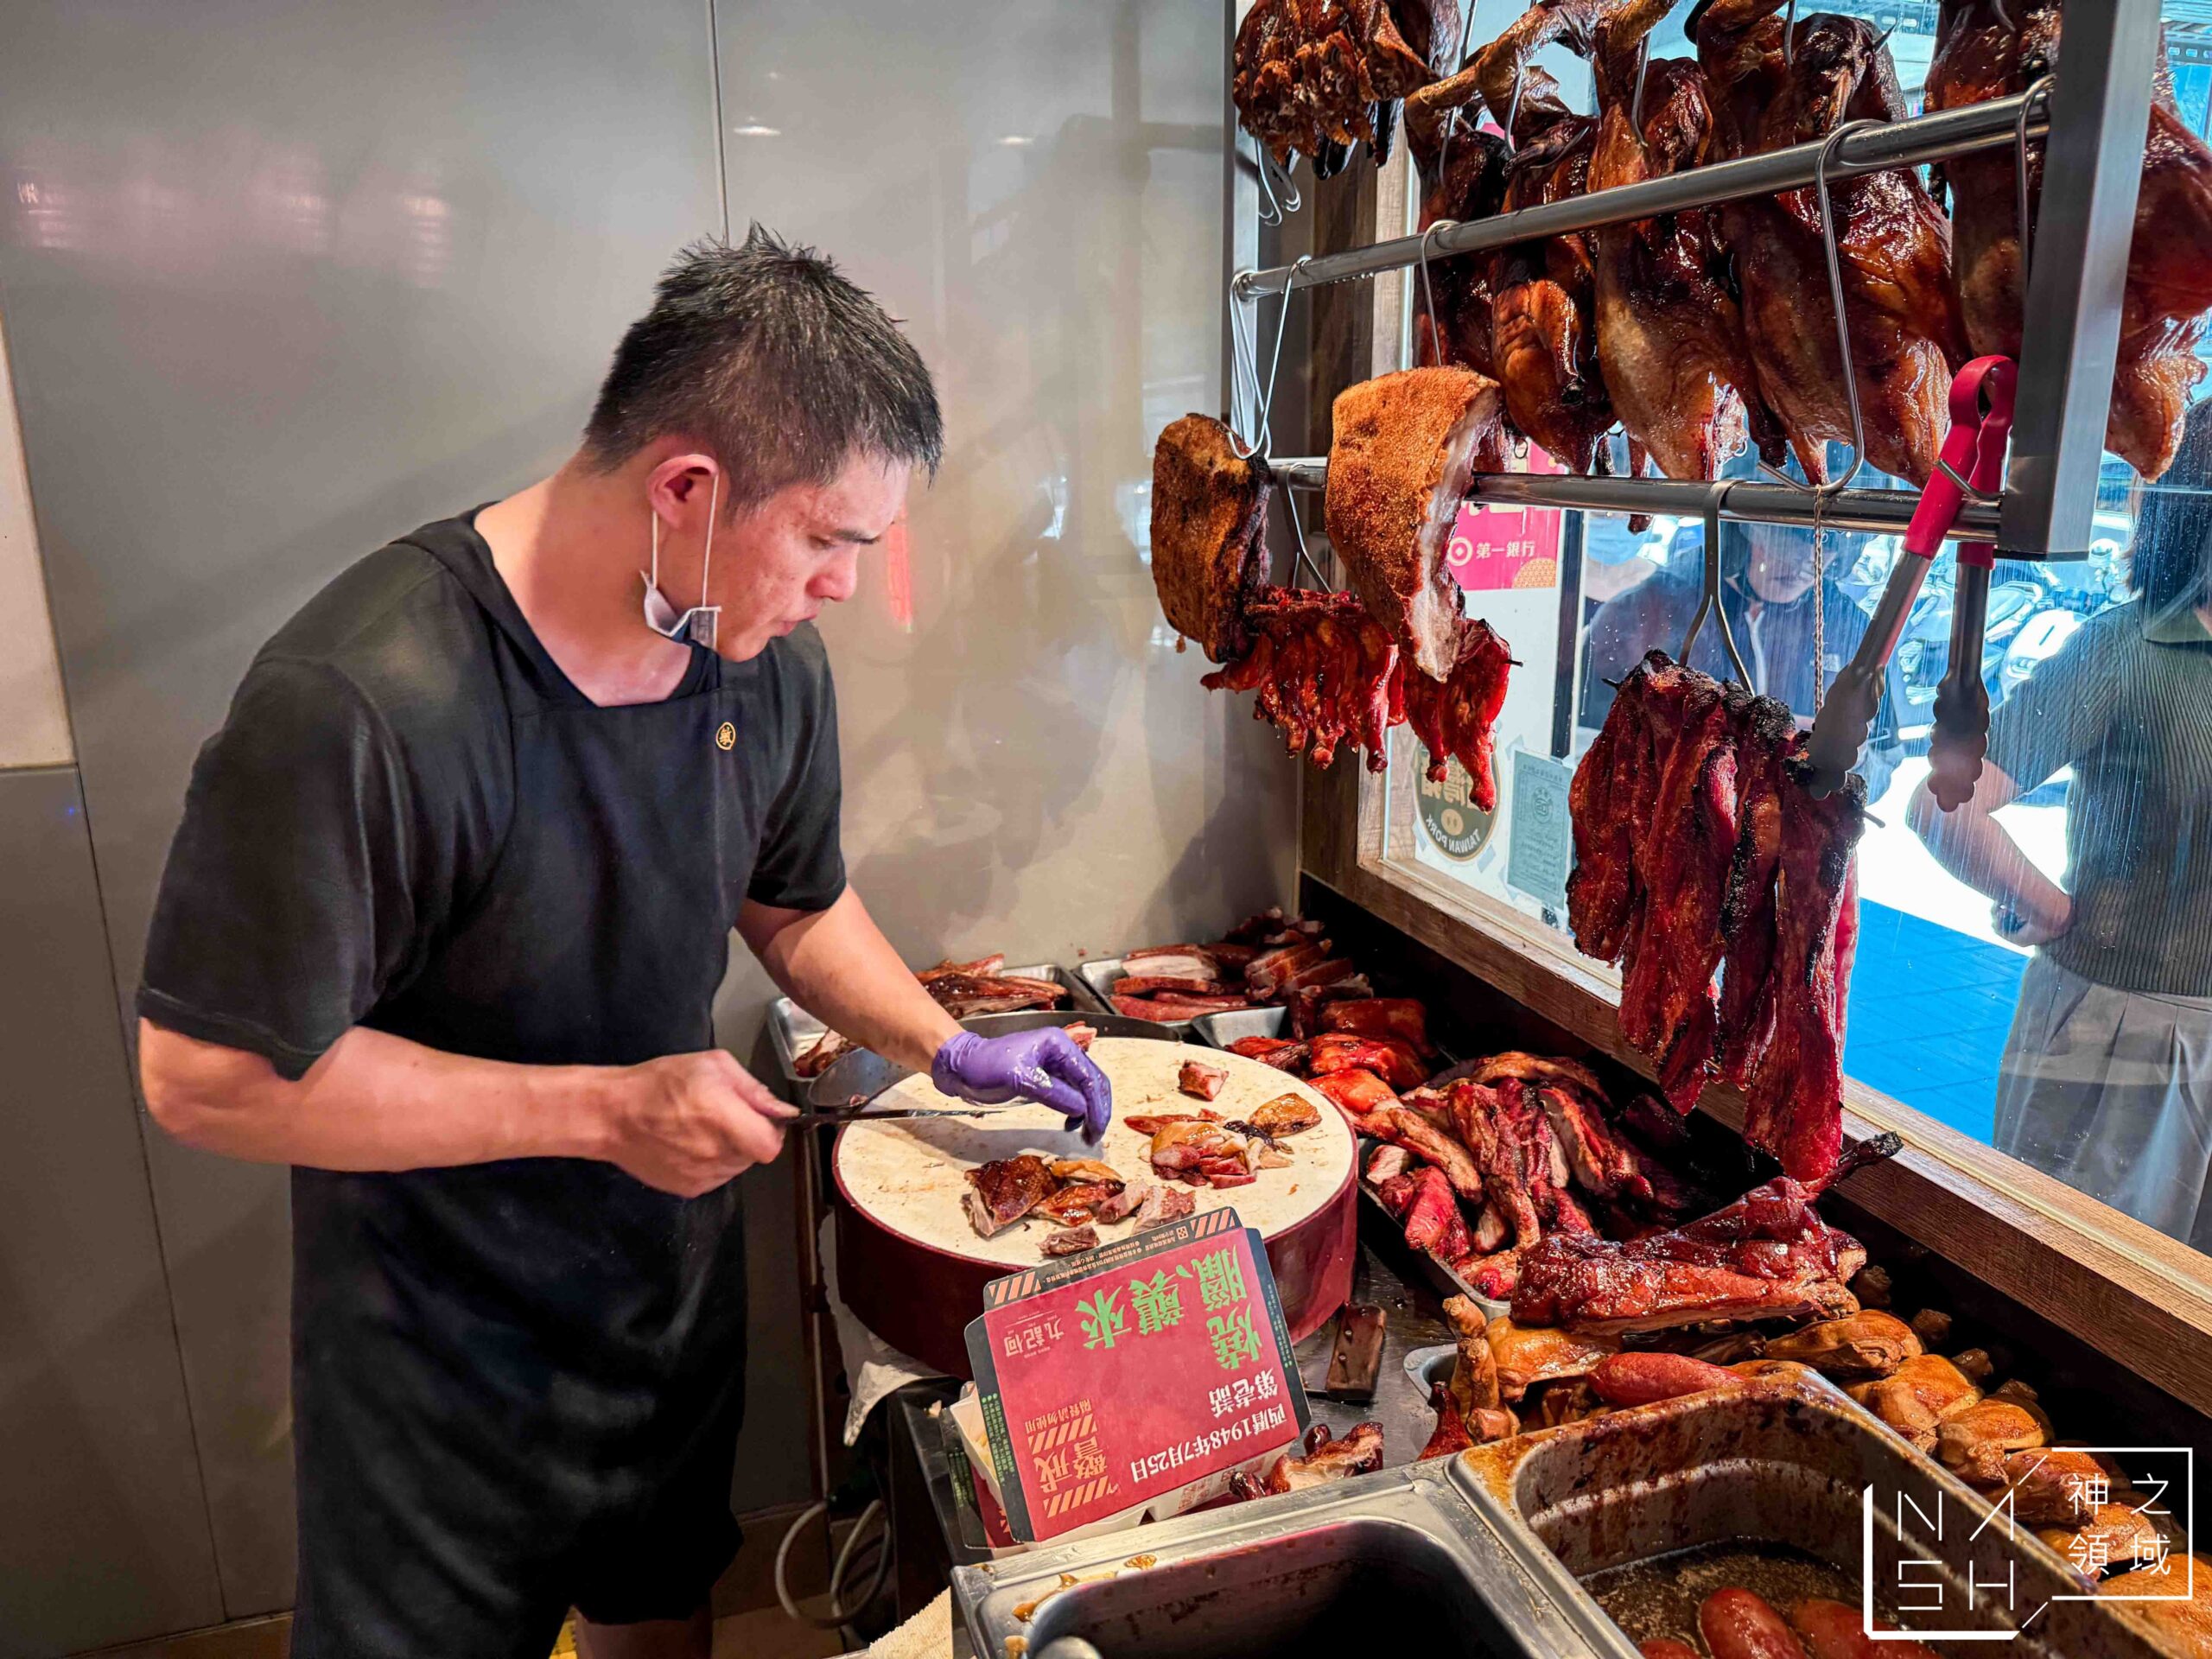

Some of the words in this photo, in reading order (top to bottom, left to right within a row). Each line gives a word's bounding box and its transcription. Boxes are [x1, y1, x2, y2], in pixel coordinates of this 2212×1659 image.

[1476, 540, 1535, 559] 第一銀行
[1024, 1398, 1092, 1434] 隔餐請勿使用
[1033, 1436, 1108, 1493] 警戒
